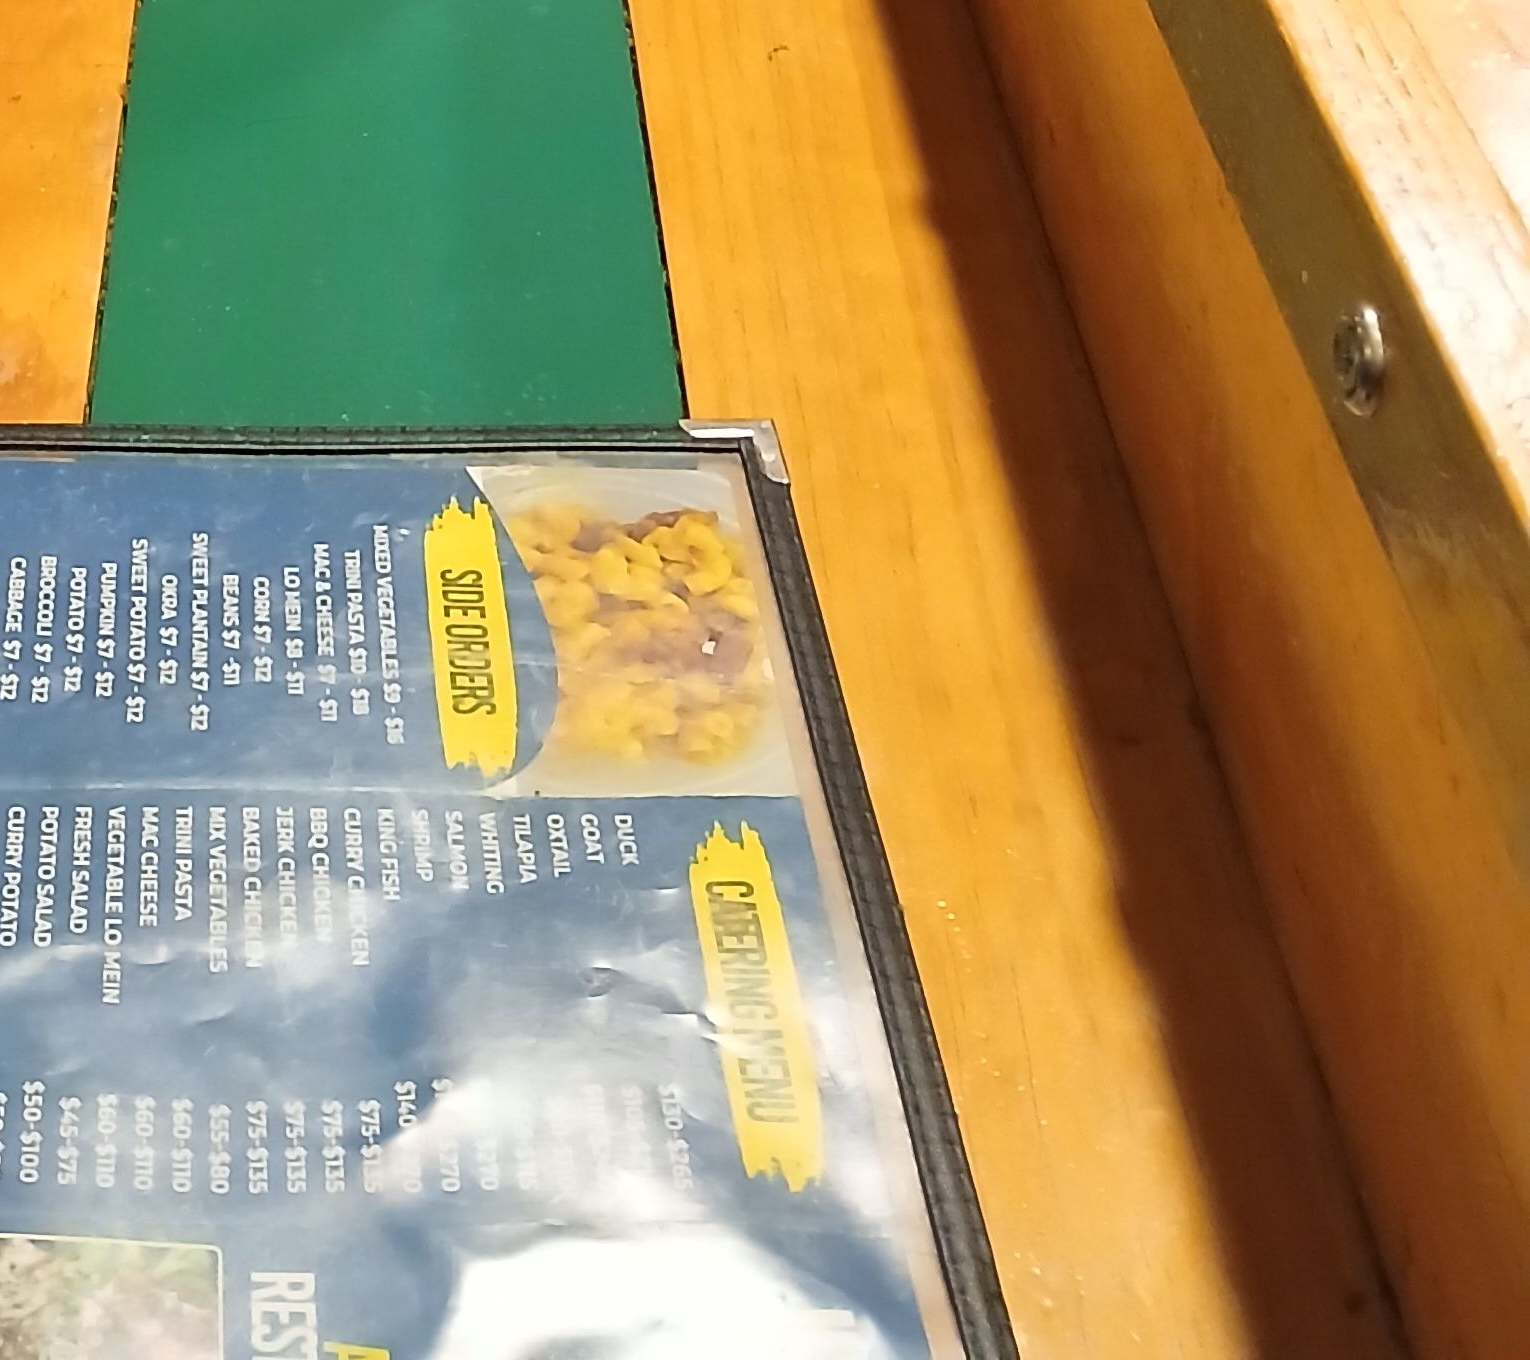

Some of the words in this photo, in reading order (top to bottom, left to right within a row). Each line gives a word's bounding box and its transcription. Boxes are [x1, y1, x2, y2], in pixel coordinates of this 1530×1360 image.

[131, 538, 148, 593] SWEET
[192, 533, 208, 586] SWEET
[314, 544, 330, 577] MAC
[316, 581, 331, 592] &
[5, 557, 26, 632] CABBAGE
[36, 556, 57, 636] BROCCOLI
[68, 568, 86, 630] POTATO
[98, 562, 117, 635] PUMPKIN
[161, 574, 178, 620] OKRA
[222, 574, 240, 626] BEANS
[254, 576, 270, 622] CORN
[440, 569, 486, 618] SIDE
[2, 640, 22, 660] $7
[34, 643, 53, 662] $7
[66, 634, 84, 653] $7
[96, 638, 115, 658] $7
[129, 596, 146, 660] POTATO
[160, 626, 178, 646] $7
[192, 590, 208, 668] PLANTAIN
[222, 630, 240, 649] $7
[253, 625, 272, 644] $7
[316, 595, 334, 656] CHEESE
[0, 674, 19, 700] $12
[31, 676, 51, 703] $12
[64, 666, 82, 692] $12
[95, 672, 114, 697] $12
[127, 664, 146, 682] $7
[159, 659, 178, 684] $12
[191, 672, 210, 692] $7
[253, 656, 272, 682] $12
[444, 624, 496, 715] ORDERS
[126, 696, 146, 723] $12
[190, 704, 210, 730] $12
[319, 699, 338, 721] $11
[5, 806, 25, 868] CURRY
[39, 806, 58, 880] POTATO
[72, 806, 92, 866] FRESH
[142, 806, 158, 848] MAC
[176, 806, 192, 854] TRINI
[209, 807, 226, 841] MIX
[242, 807, 260, 872] BAKED
[344, 808, 364, 872] CURRY
[377, 808, 398, 854] KING
[411, 809, 434, 881] SHRIMP
[444, 810, 470, 890] SALMON
[513, 814, 538, 884] TILAPIA
[546, 814, 571, 878] OXTAIL
[580, 814, 604, 864] GOAT
[614, 814, 640, 866] DUCK
[104, 806, 126, 913] VEGETABLE
[380, 858, 400, 900] FISH
[479, 812, 504, 894] WHITING
[34, 884, 54, 947] SALAD
[70, 870, 89, 933] SALAD
[140, 852, 158, 926] CHEESE
[174, 859, 192, 921] PASTA
[209, 846, 228, 972] VEGETABLES
[104, 918, 122, 946] LO
[244, 877, 262, 968] CHICKEN
[348, 876, 369, 966] CHICKEN
[706, 881, 778, 1019] CATERING
[102, 951, 120, 1004] MEIN
[732, 1029, 799, 1124] MENU
[19, 1080, 45, 1183] $50-$100
[208, 1104, 232, 1193] $55-$80
[246, 1101, 268, 1194] $75-$135
[284, 1101, 306, 1193] $75-$135
[321, 1100, 344, 1192] $75-$135
